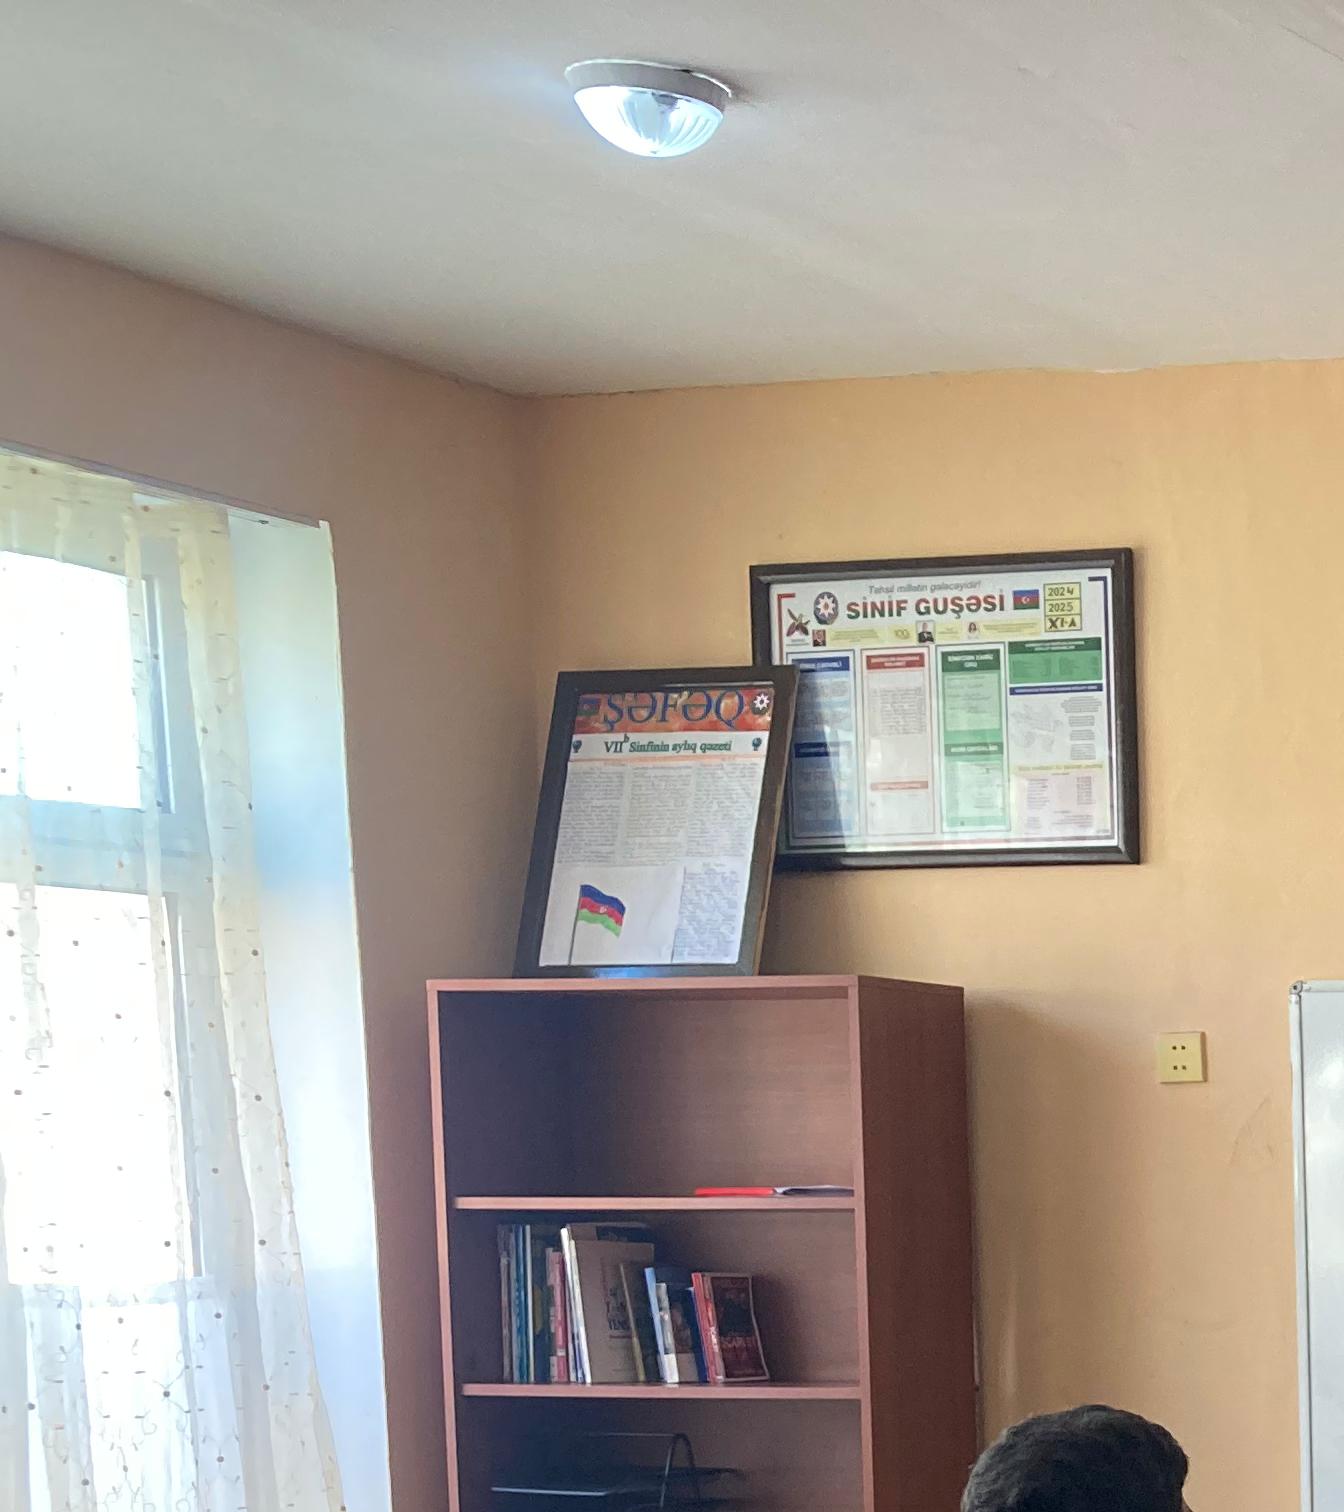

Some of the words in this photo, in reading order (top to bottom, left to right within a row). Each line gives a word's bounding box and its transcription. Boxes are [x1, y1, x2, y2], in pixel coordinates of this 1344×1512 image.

[1047, 586, 1074, 597] 2024
[846, 595, 908, 619] SİNİF
[915, 589, 1005, 619] GUŞƏSİ
[1047, 602, 1074, 613] 2025
